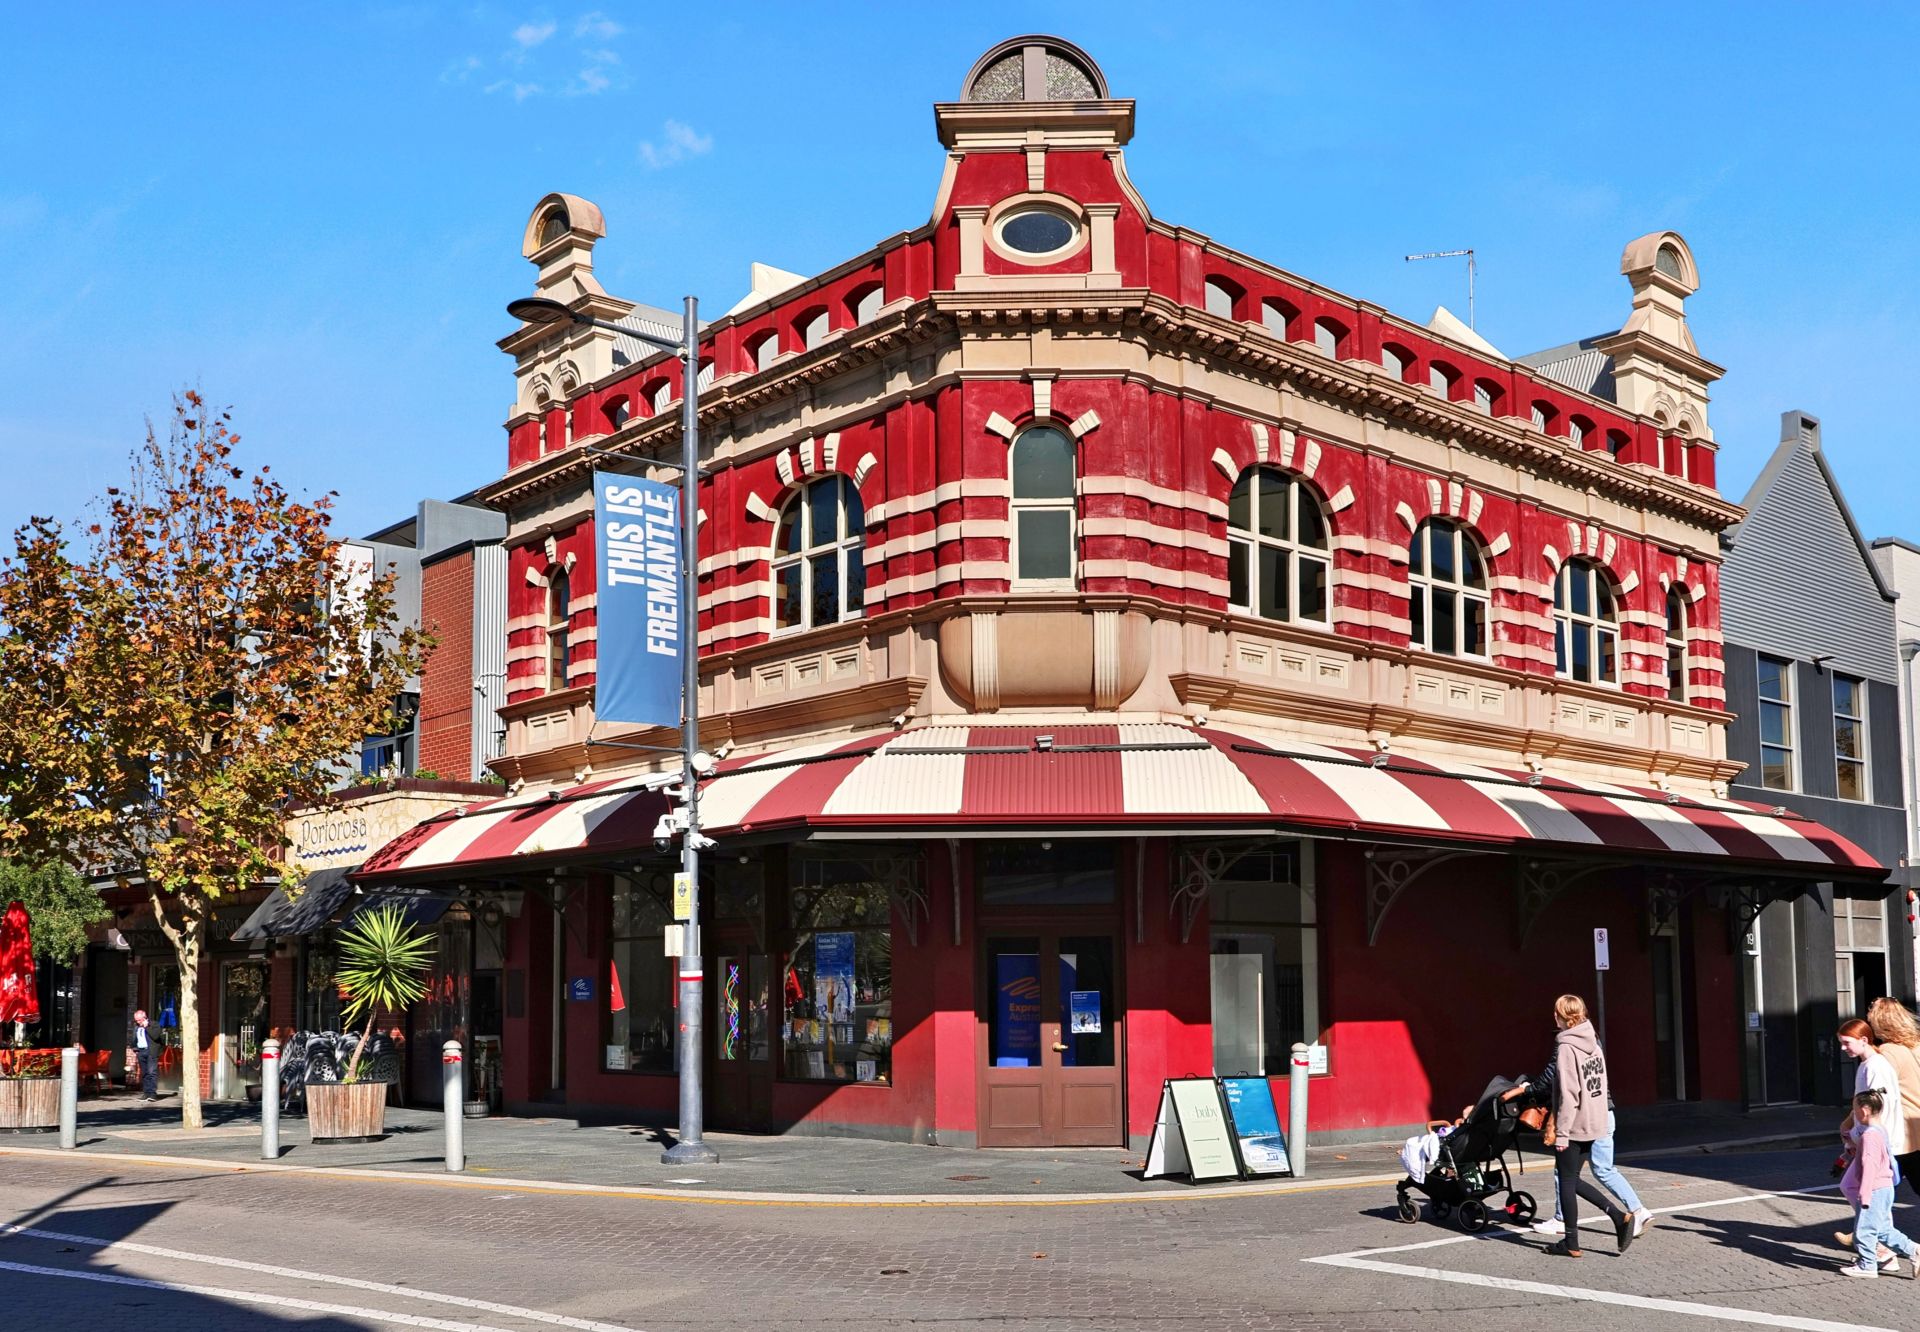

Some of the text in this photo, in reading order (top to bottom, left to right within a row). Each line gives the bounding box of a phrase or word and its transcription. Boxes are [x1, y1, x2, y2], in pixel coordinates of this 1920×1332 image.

[605, 485, 645, 587] THIS IS
[645, 490, 678, 657] FREMANTLE
[302, 816, 367, 847] Portorosa
[1746, 933, 1754, 945] 19
